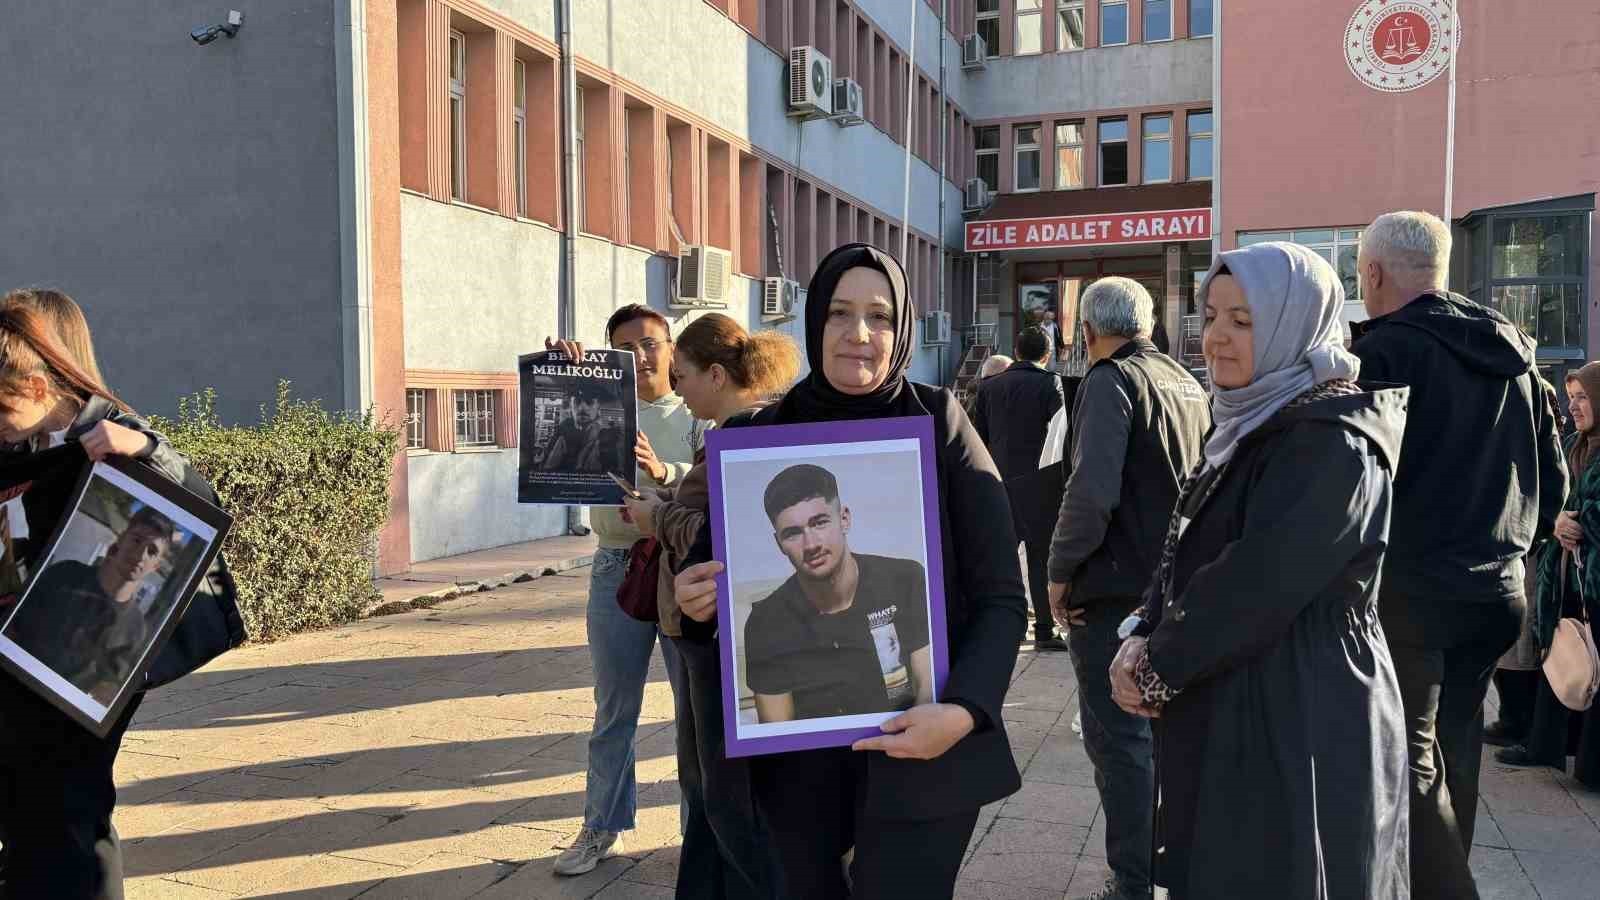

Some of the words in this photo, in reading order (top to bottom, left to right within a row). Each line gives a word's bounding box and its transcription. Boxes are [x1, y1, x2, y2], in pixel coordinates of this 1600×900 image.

[972, 223, 1017, 246] ZİLE
[1025, 220, 1112, 243] ADALET
[1121, 215, 1204, 238] SARAYI
[548, 352, 608, 362] BEKAY
[532, 364, 623, 380] MELİKOĞLU
